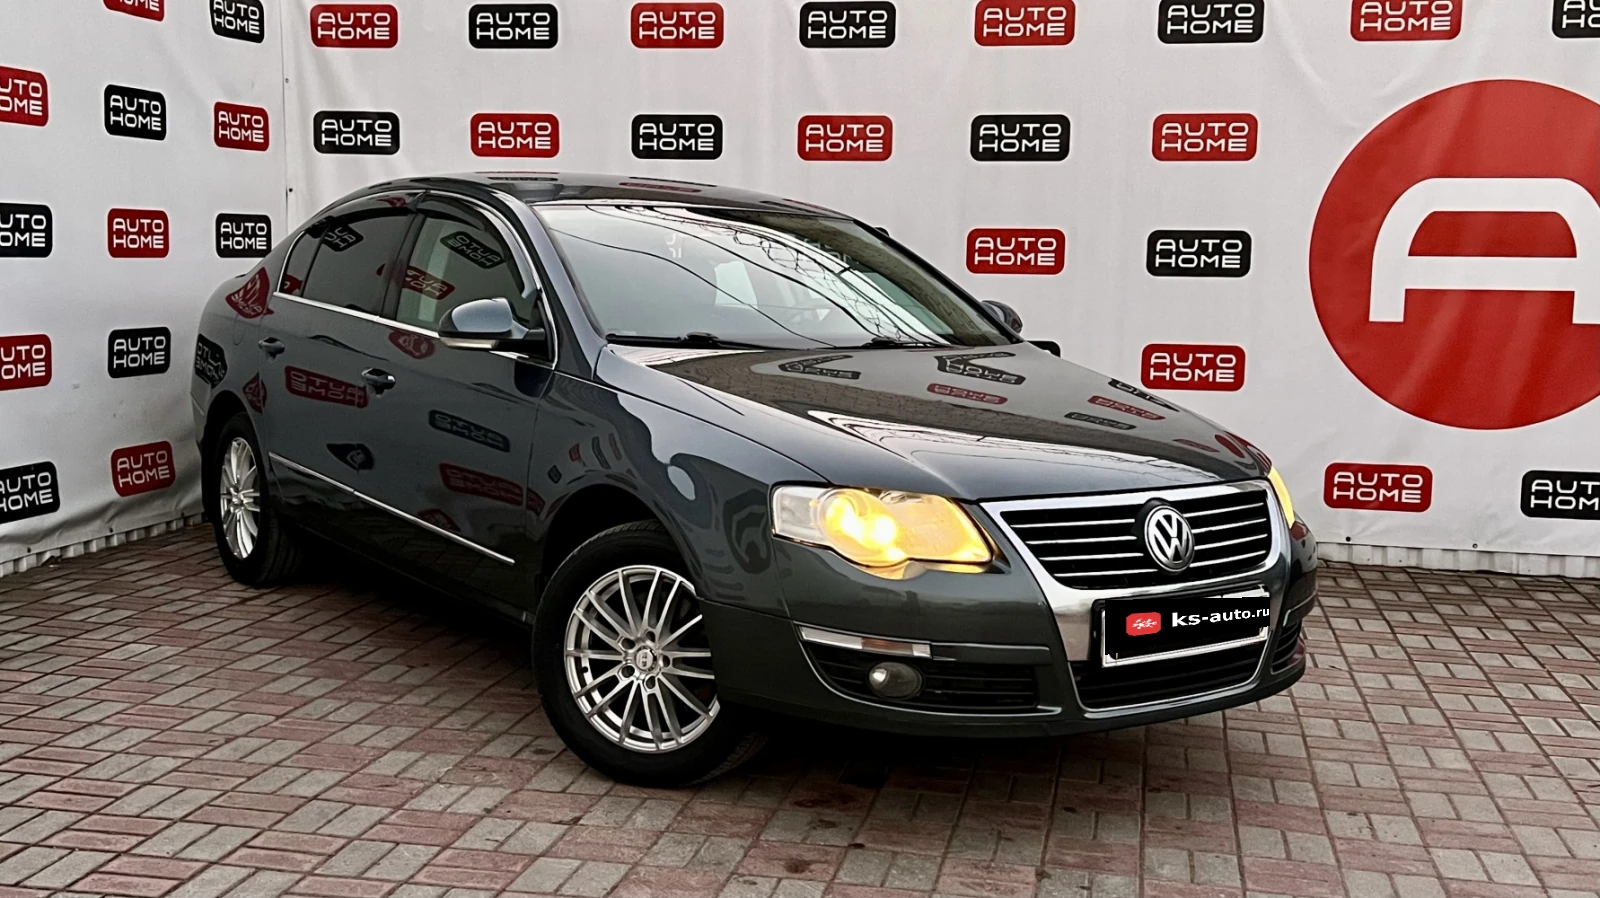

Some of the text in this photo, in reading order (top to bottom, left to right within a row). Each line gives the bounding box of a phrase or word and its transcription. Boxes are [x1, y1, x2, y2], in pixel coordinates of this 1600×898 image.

[213, 0, 260, 20] AUTO
[983, 6, 1067, 22] AUTO
[1167, 3, 1256, 19] AUTO
[1360, 0, 1454, 16] AUTO
[213, 12, 260, 35] HOME
[317, 12, 391, 26] AUTO
[476, 12, 551, 25] AUTO
[638, 11, 716, 25] AUTO
[807, 9, 888, 24] AUTO
[1359, 16, 1452, 32] HOME
[1561, 13, 1600, 29] HO
[317, 26, 390, 40] HOME
[476, 27, 550, 40] HOME
[638, 26, 715, 40] HOME
[807, 25, 887, 40] HOME
[983, 22, 1066, 37] HOME
[1166, 19, 1254, 35] HOME
[0, 78, 43, 98] UTO
[0, 95, 43, 116] OME
[109, 94, 162, 115] AUTO
[110, 110, 162, 131] HOME
[218, 110, 264, 129] AUTO
[321, 118, 393, 133] AUTO
[218, 125, 265, 143] HOME
[477, 121, 552, 135] AUTO
[639, 122, 715, 137] AUTO
[805, 123, 885, 138] AUTO
[979, 123, 1062, 137] AUTO
[1161, 122, 1249, 137] AUTO
[321, 133, 392, 147] HOME
[478, 136, 551, 150] HOME
[639, 137, 714, 151] HOME
[805, 138, 884, 153] HOME
[978, 138, 1061, 153] HOME
[1161, 138, 1248, 153] HOME
[0, 213, 47, 230] UTO
[112, 217, 164, 233] AUTO
[220, 221, 268, 236] AUTO
[0, 231, 46, 248] OME
[113, 234, 164, 249] HOME
[220, 236, 267, 250] HOME
[975, 236, 1057, 251] AUTO
[1155, 238, 1243, 253] AUTO
[974, 251, 1056, 266] HOME
[1155, 254, 1241, 269] HOME
[113, 336, 166, 353] AUTO
[0, 344, 46, 362] UTO
[113, 351, 165, 369] HOME
[1150, 352, 1237, 368] AUTO
[1, 361, 46, 380] OME
[1149, 367, 1235, 383] HOME
[116, 450, 168, 472] AUTO
[117, 465, 171, 488] HOME
[1333, 471, 1424, 488] AUTO
[1332, 486, 1422, 504] HOME
[1531, 479, 1600, 495] AUT
[1530, 494, 1600, 511] HOM
